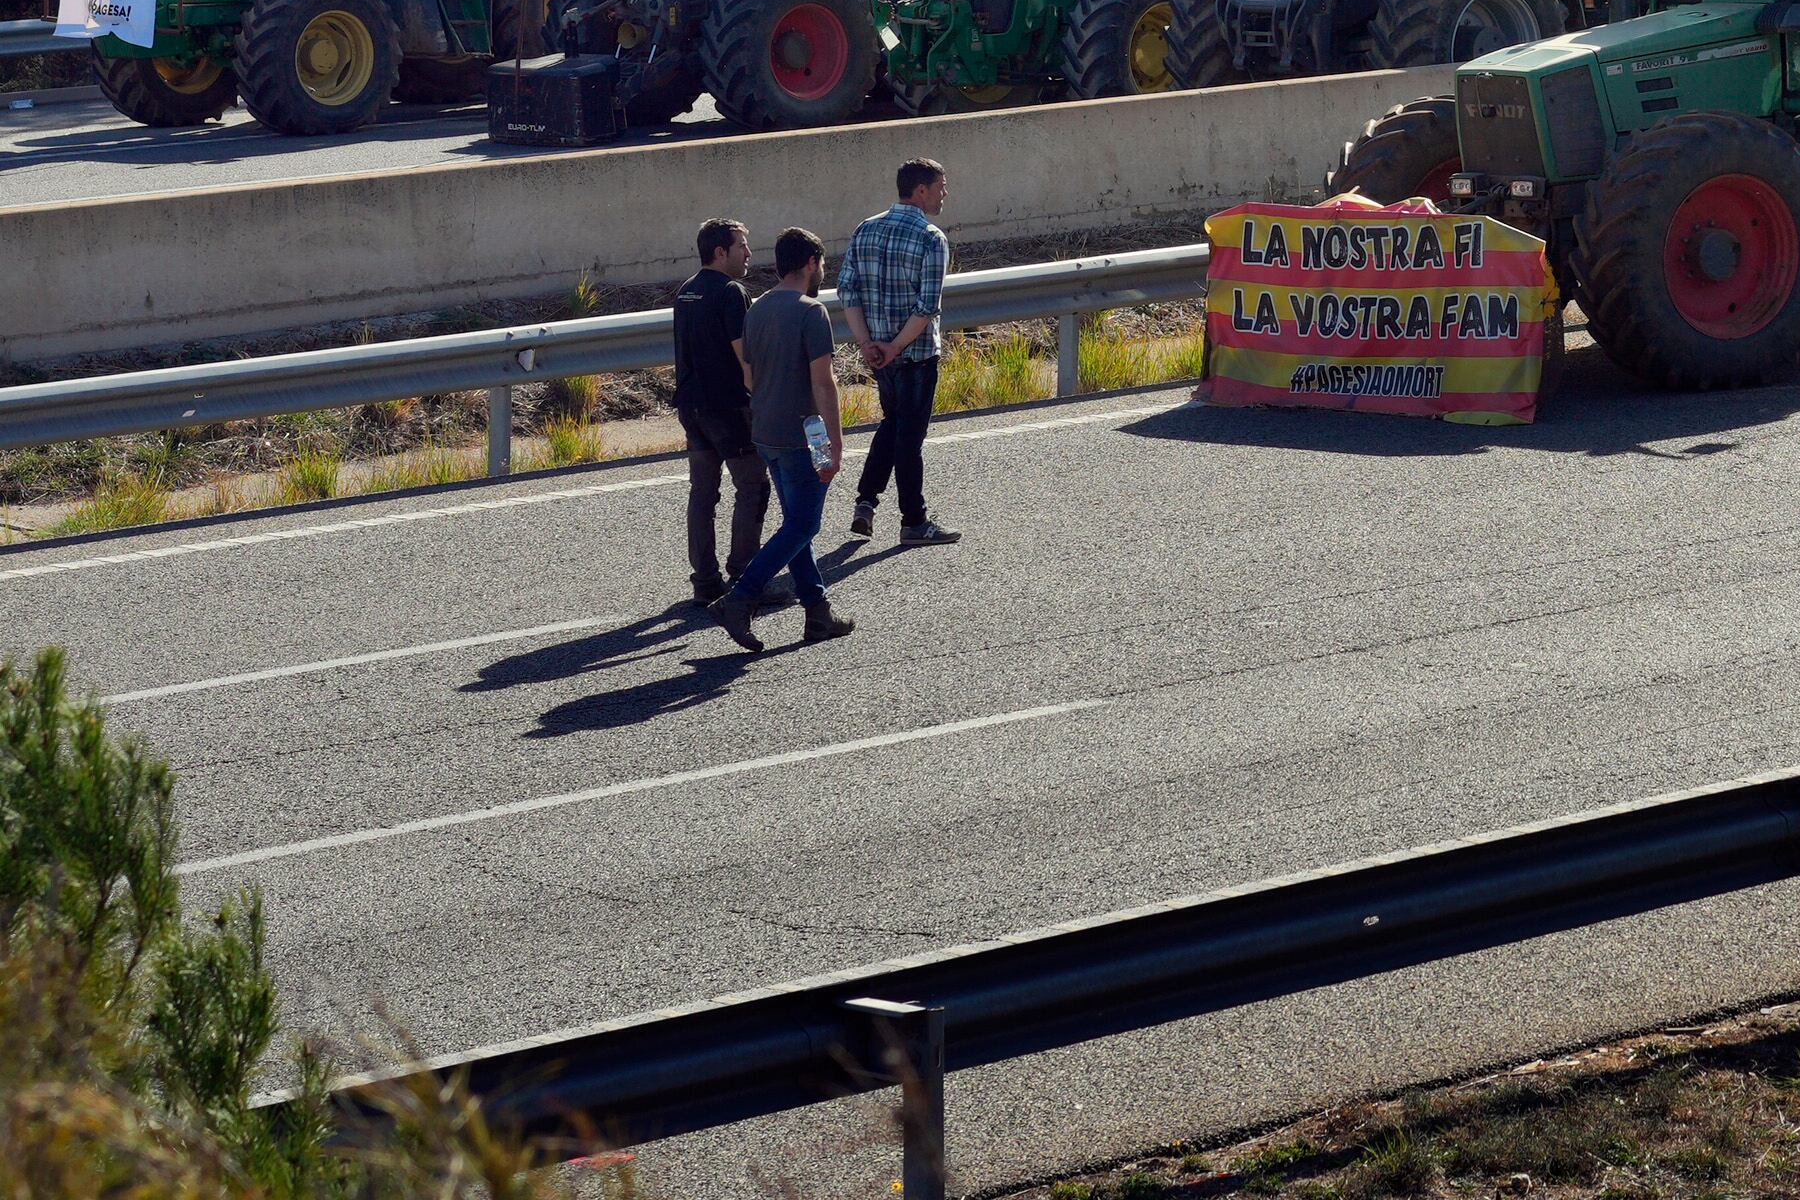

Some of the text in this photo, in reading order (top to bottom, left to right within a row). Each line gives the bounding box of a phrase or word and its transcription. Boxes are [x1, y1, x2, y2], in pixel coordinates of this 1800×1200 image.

[91, 5, 132, 22] PAGESA!
[1465, 103, 1527, 119] FNDT
[1240, 219, 1485, 271] LA NOSTRA FI
[1231, 287, 1520, 340] LA VOSTRA FAM
[1290, 363, 1445, 399] #PAGESIAOMORT
